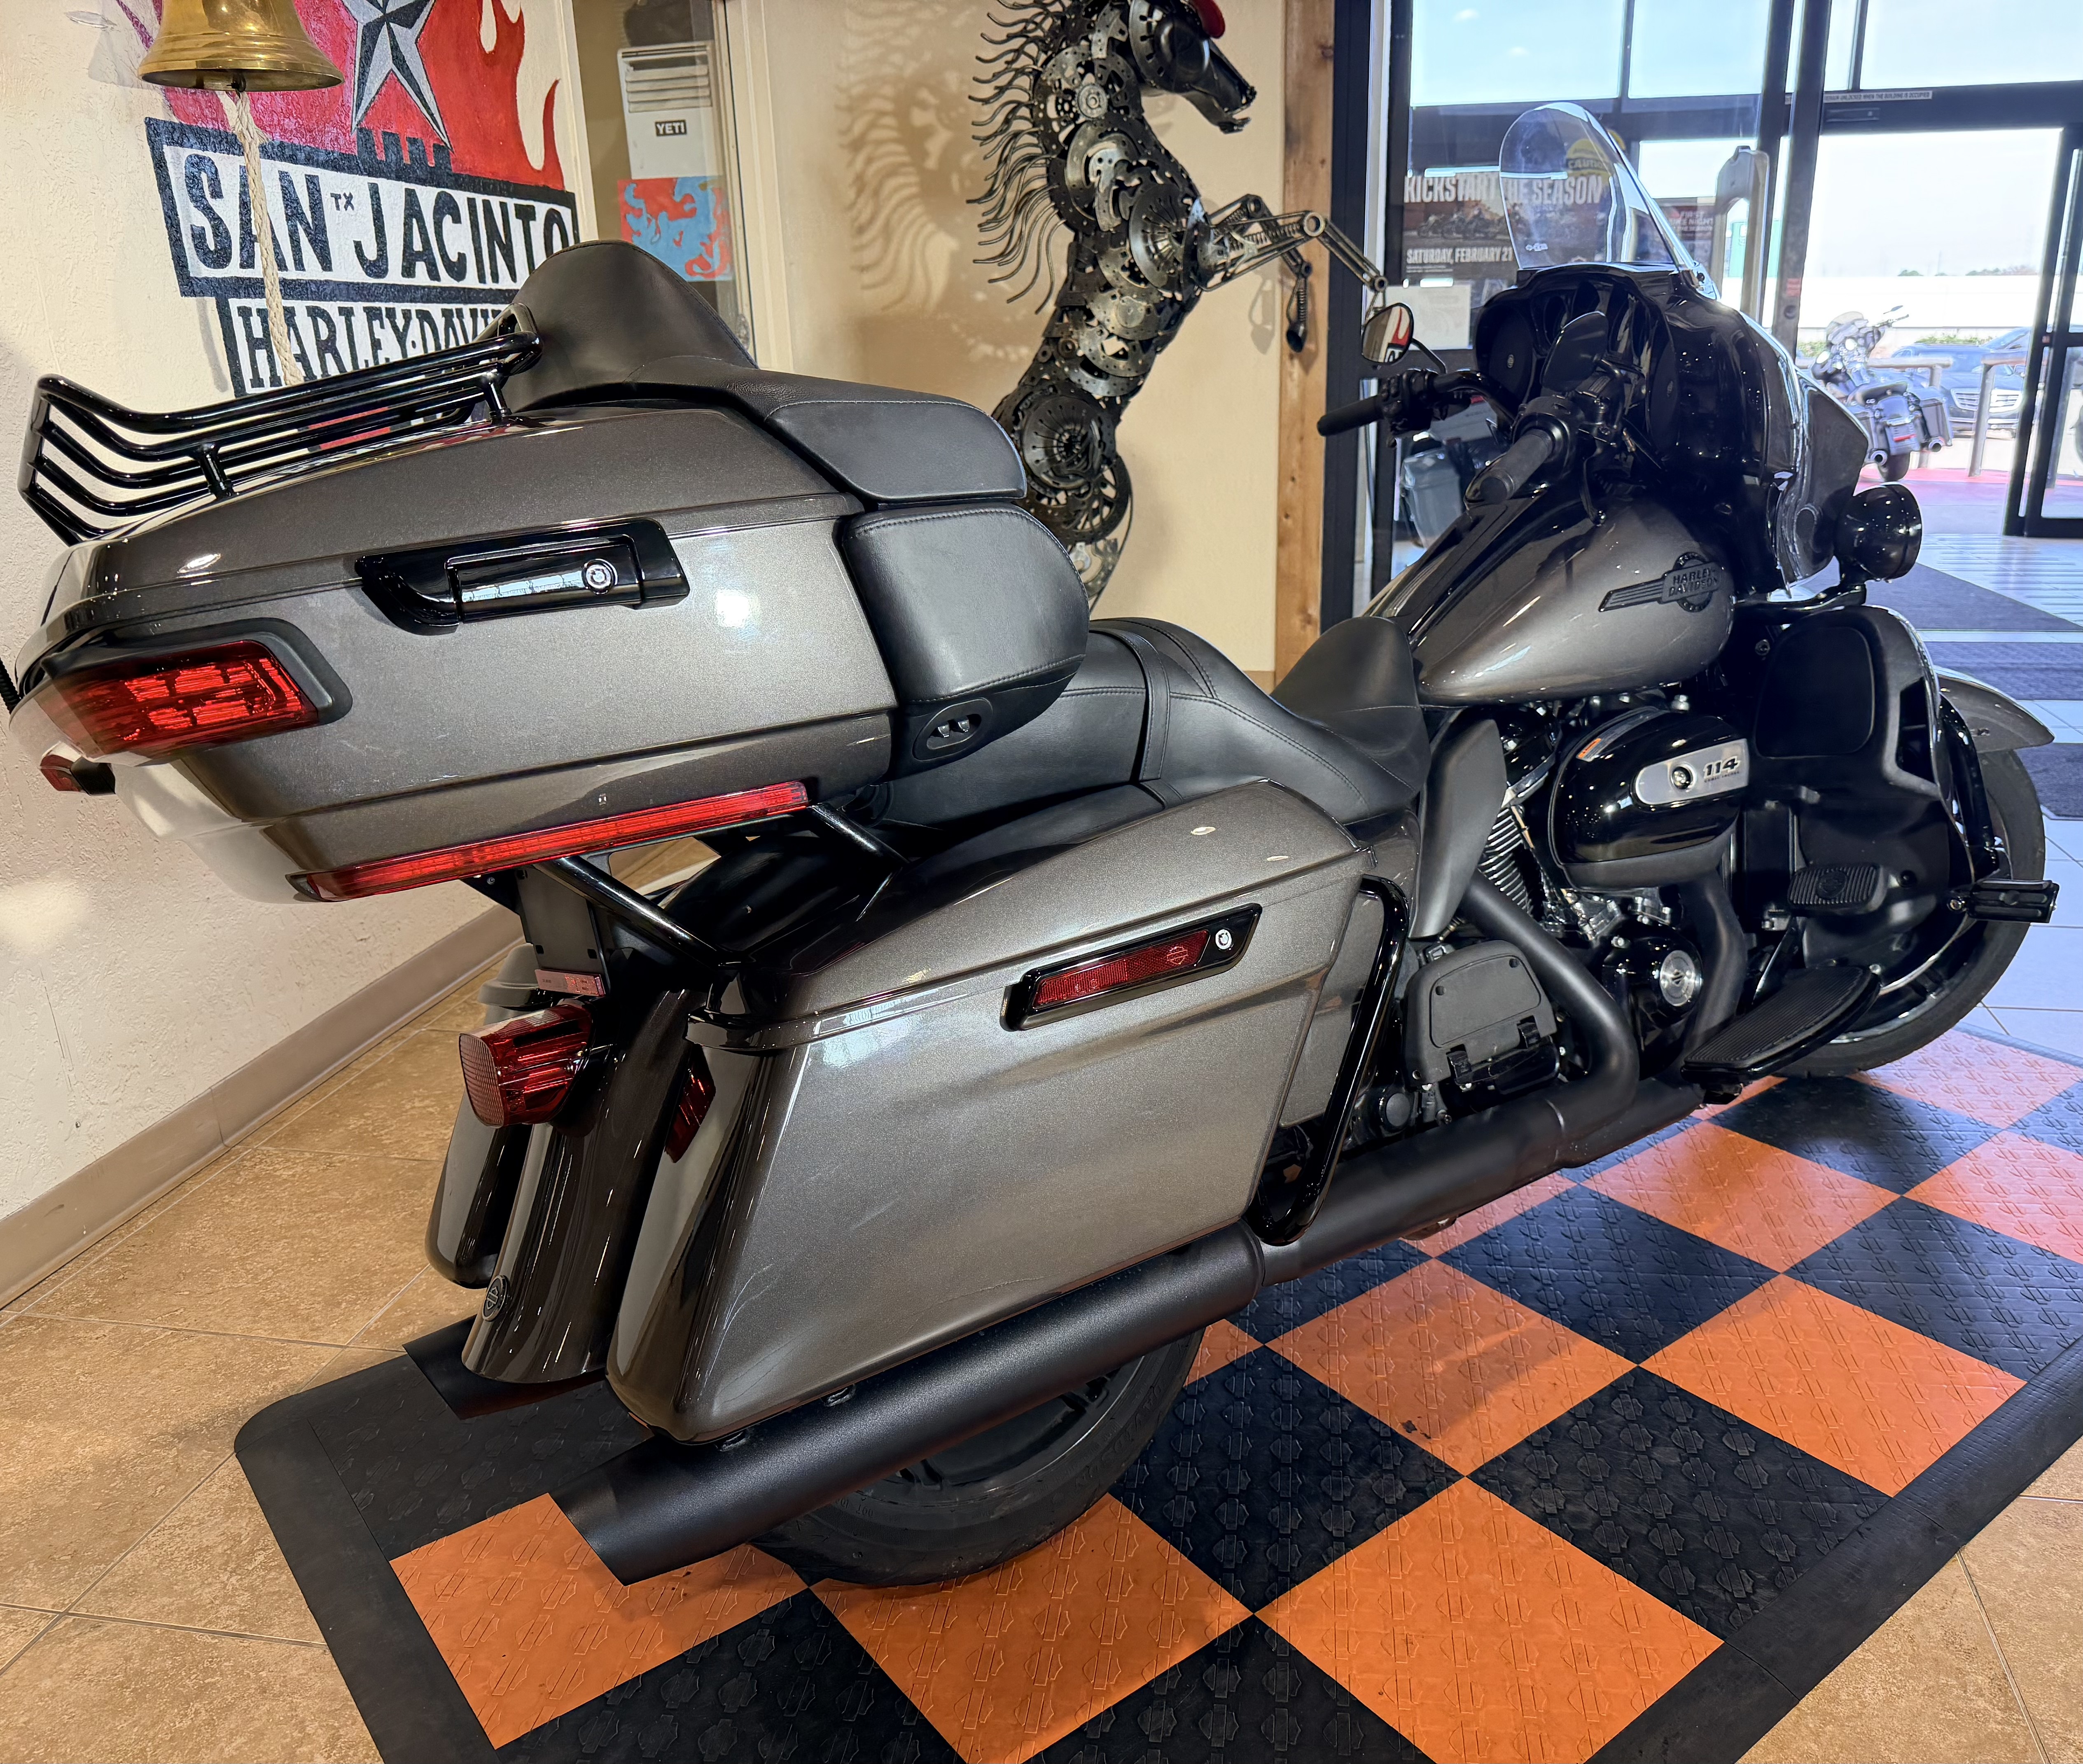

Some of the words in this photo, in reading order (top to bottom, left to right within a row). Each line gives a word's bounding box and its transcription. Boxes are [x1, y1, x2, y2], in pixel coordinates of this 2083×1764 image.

[656, 121, 685, 134] YETI
[1532, 175, 1602, 205] SEASON
[185, 154, 333, 272] SAN
[330, 192, 354, 211] TX
[1406, 248, 1454, 264] SATURDAY,
[1455, 247, 1502, 262] FEBRUARY
[1502, 246, 1513, 262] 21
[1669, 577, 1718, 597] DAVIDSON
[1704, 756, 1740, 778] 114
